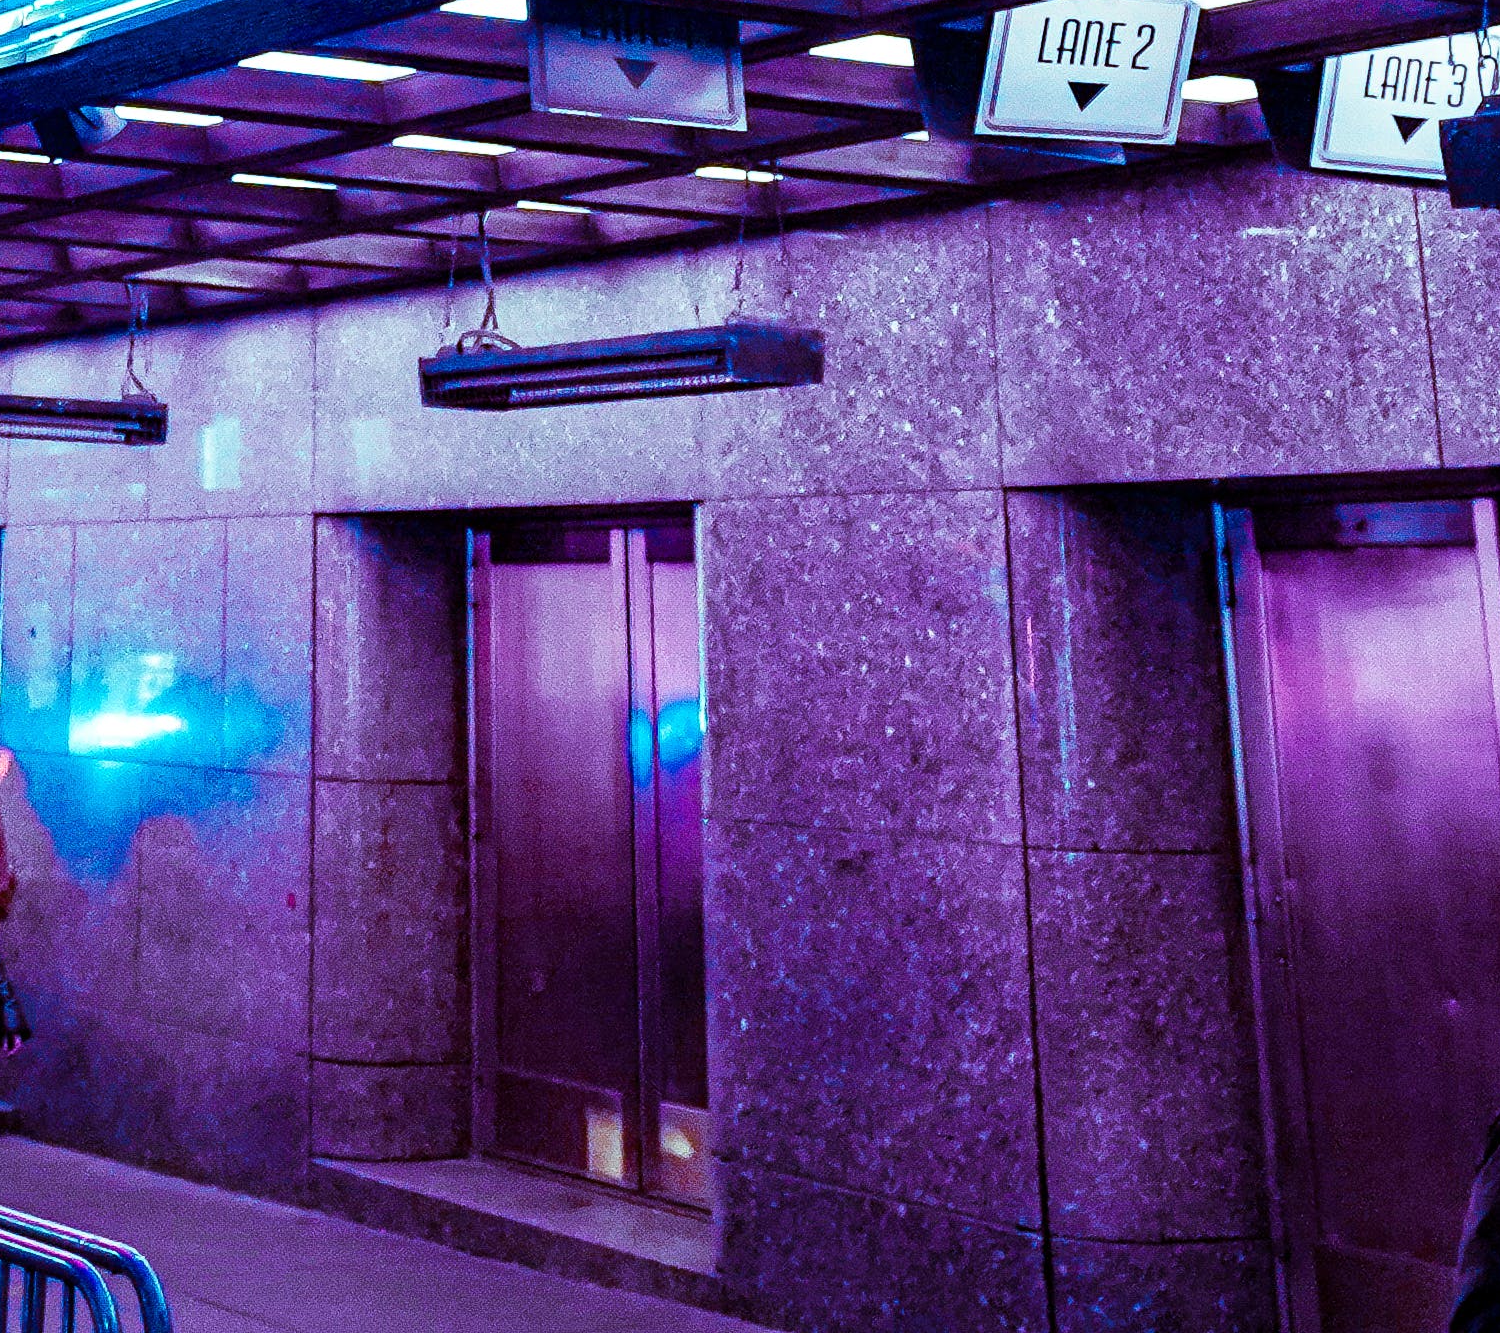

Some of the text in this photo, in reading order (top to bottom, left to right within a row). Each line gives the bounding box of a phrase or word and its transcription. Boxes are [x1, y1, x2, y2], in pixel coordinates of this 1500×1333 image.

[1036, 17, 1157, 71] LANE 2
[1362, 53, 1469, 108] LANE 3
